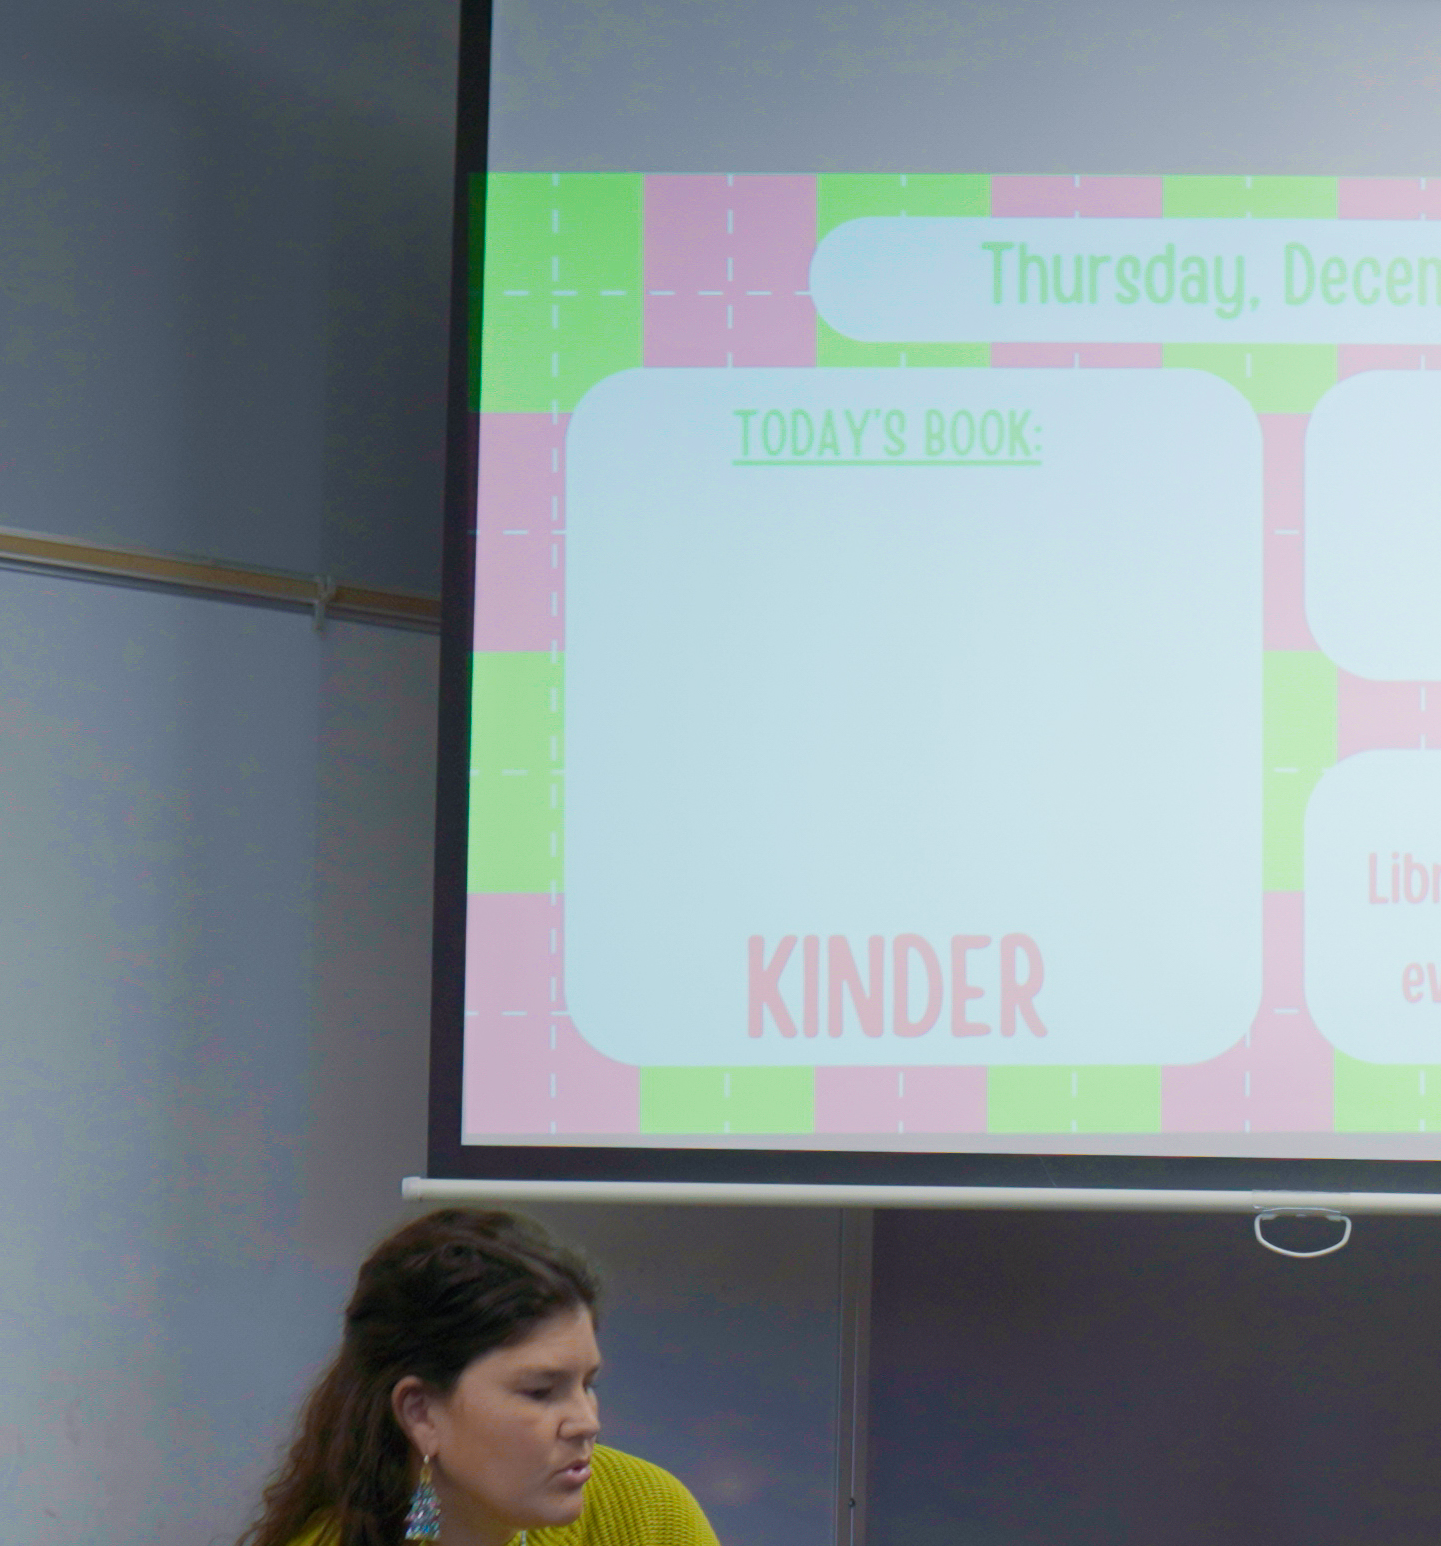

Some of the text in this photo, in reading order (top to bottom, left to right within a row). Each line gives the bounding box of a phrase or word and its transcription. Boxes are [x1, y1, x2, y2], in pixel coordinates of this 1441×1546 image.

[982, 241, 1261, 321] Thursday,
[732, 408, 1043, 460] TODAY'S BOOK:
[747, 933, 1048, 1039] KINDER
